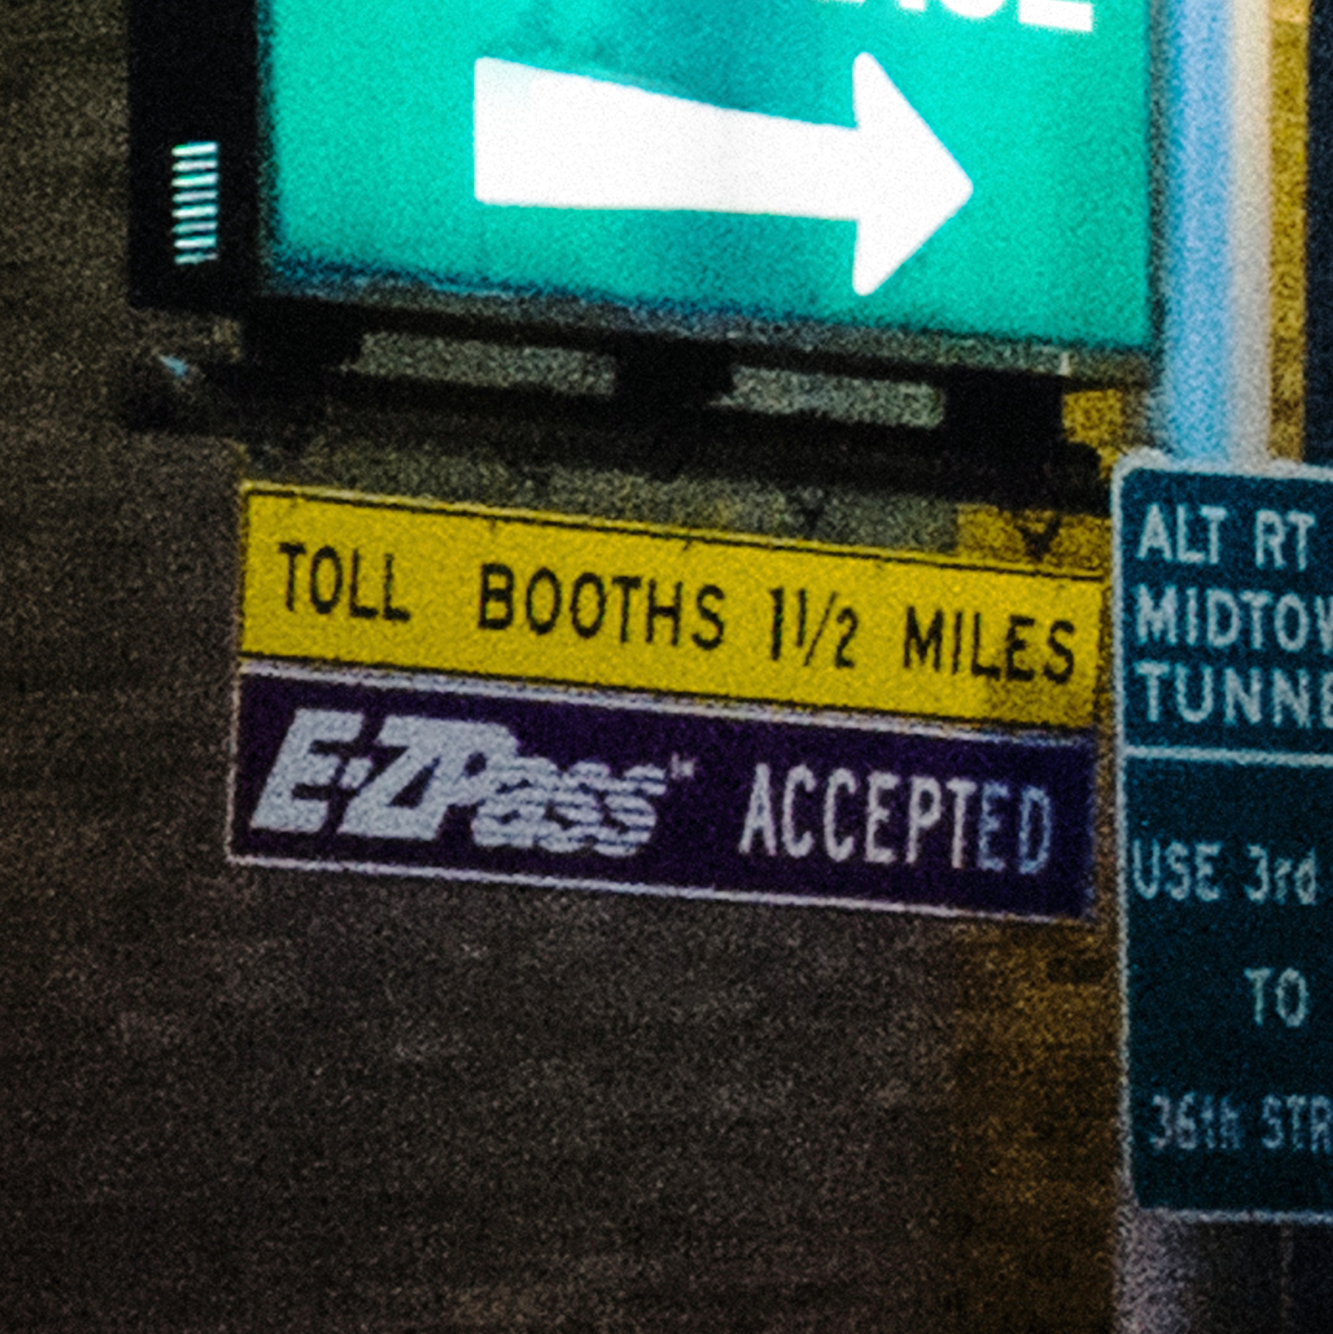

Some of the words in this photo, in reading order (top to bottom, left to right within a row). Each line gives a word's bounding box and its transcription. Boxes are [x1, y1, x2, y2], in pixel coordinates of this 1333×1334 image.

[1136, 503, 1227, 565] ALT
[1255, 509, 1316, 570] RT
[278, 543, 411, 622] TOLL
[477, 563, 726, 651] BOOTHS
[902, 605, 1076, 685] MILES
[738, 763, 1053, 875] ACCEPTED
[1132, 838, 1222, 902] USE
[1246, 844, 1317, 907] 3rd
[1244, 967, 1308, 1029] TO
[1150, 1091, 1241, 1151] 36th
